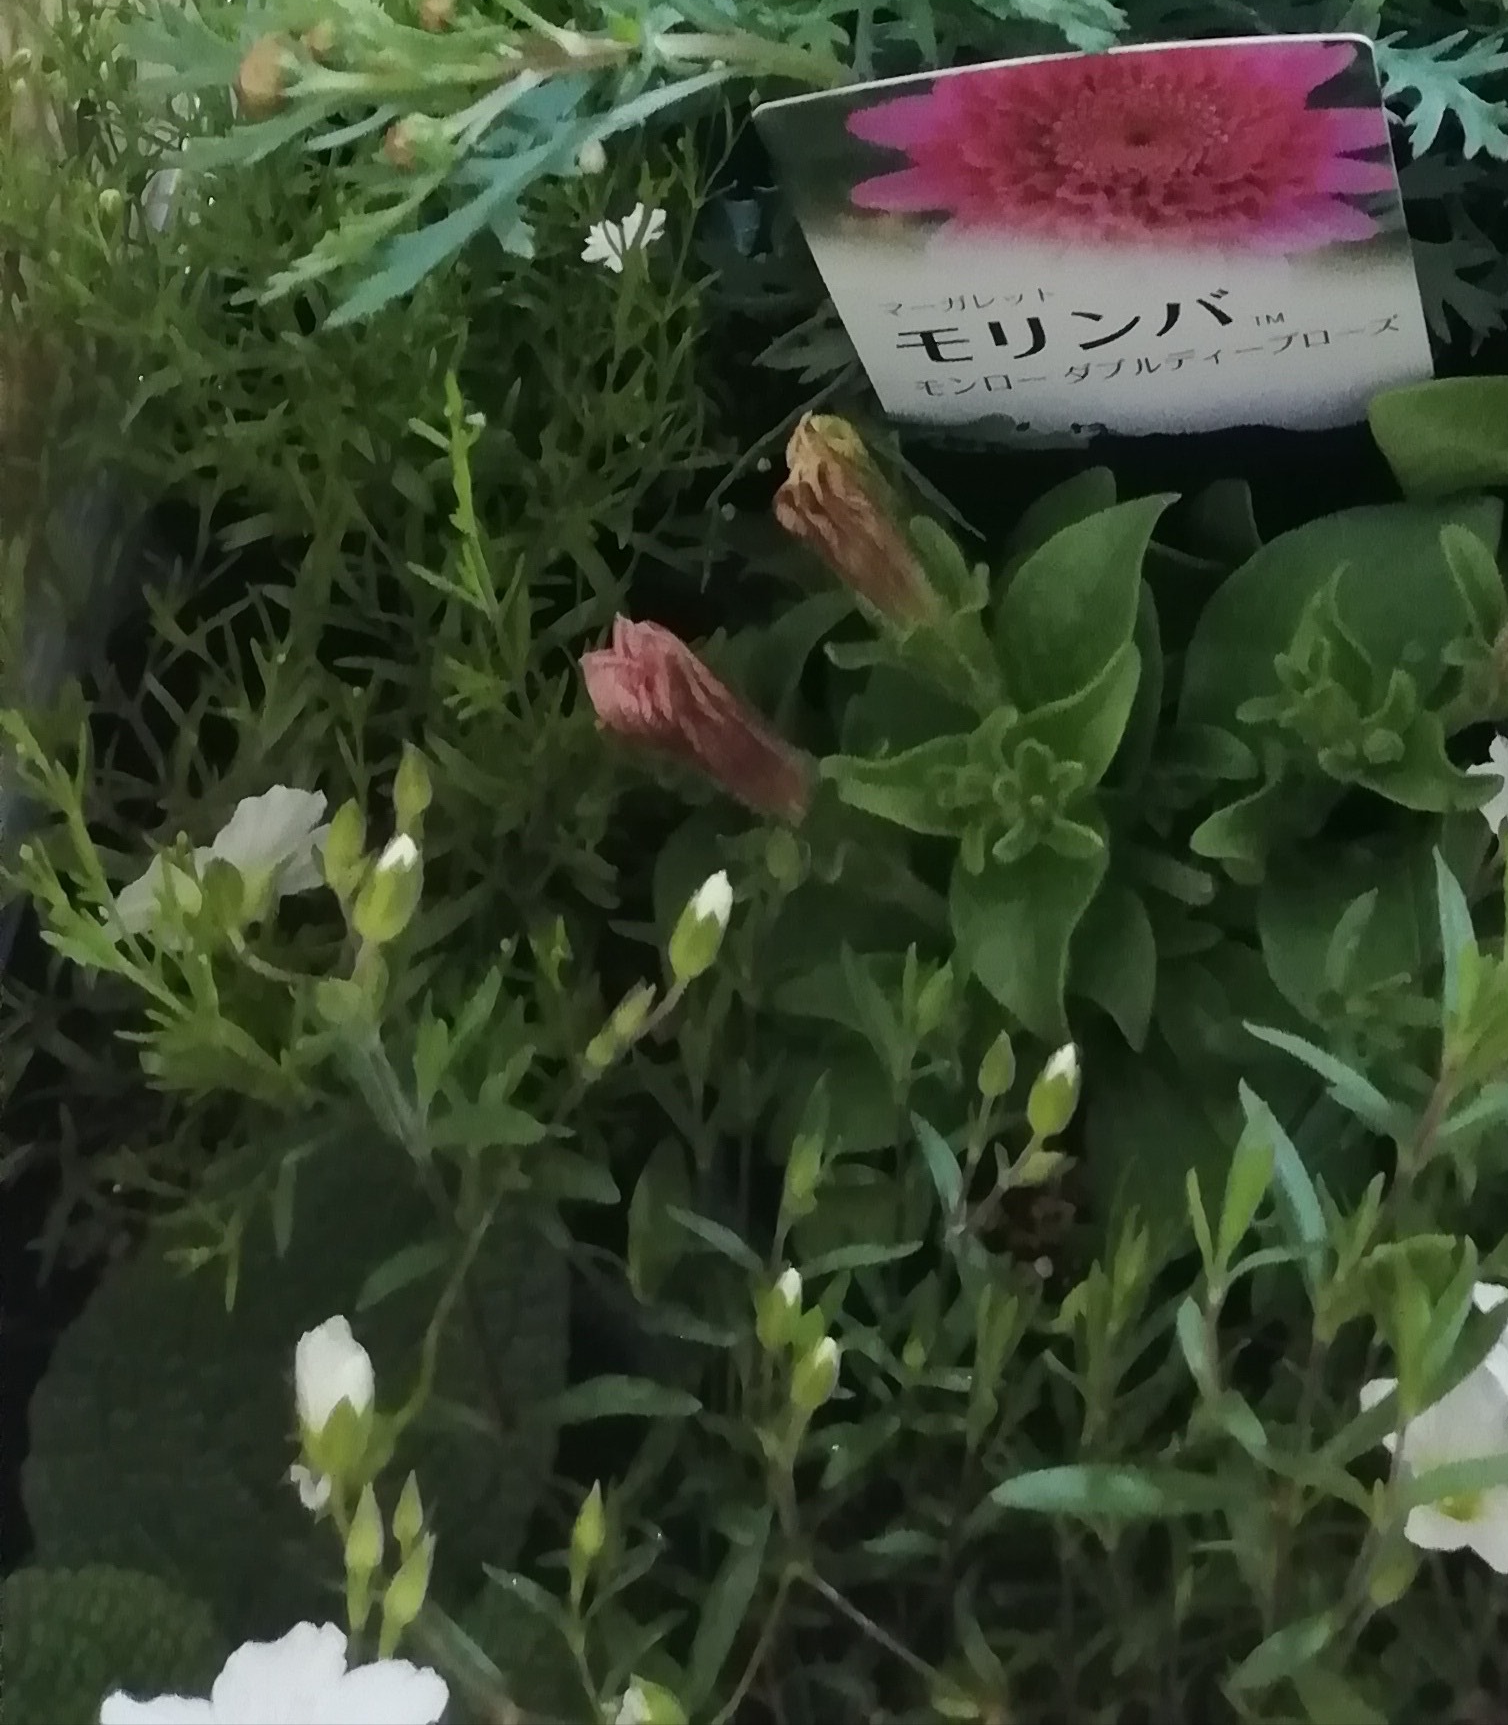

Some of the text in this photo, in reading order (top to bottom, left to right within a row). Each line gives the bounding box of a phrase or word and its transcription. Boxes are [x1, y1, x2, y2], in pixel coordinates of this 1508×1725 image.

[879, 288, 1055, 316] マーガレット
[896, 288, 1234, 363] モリンバ
